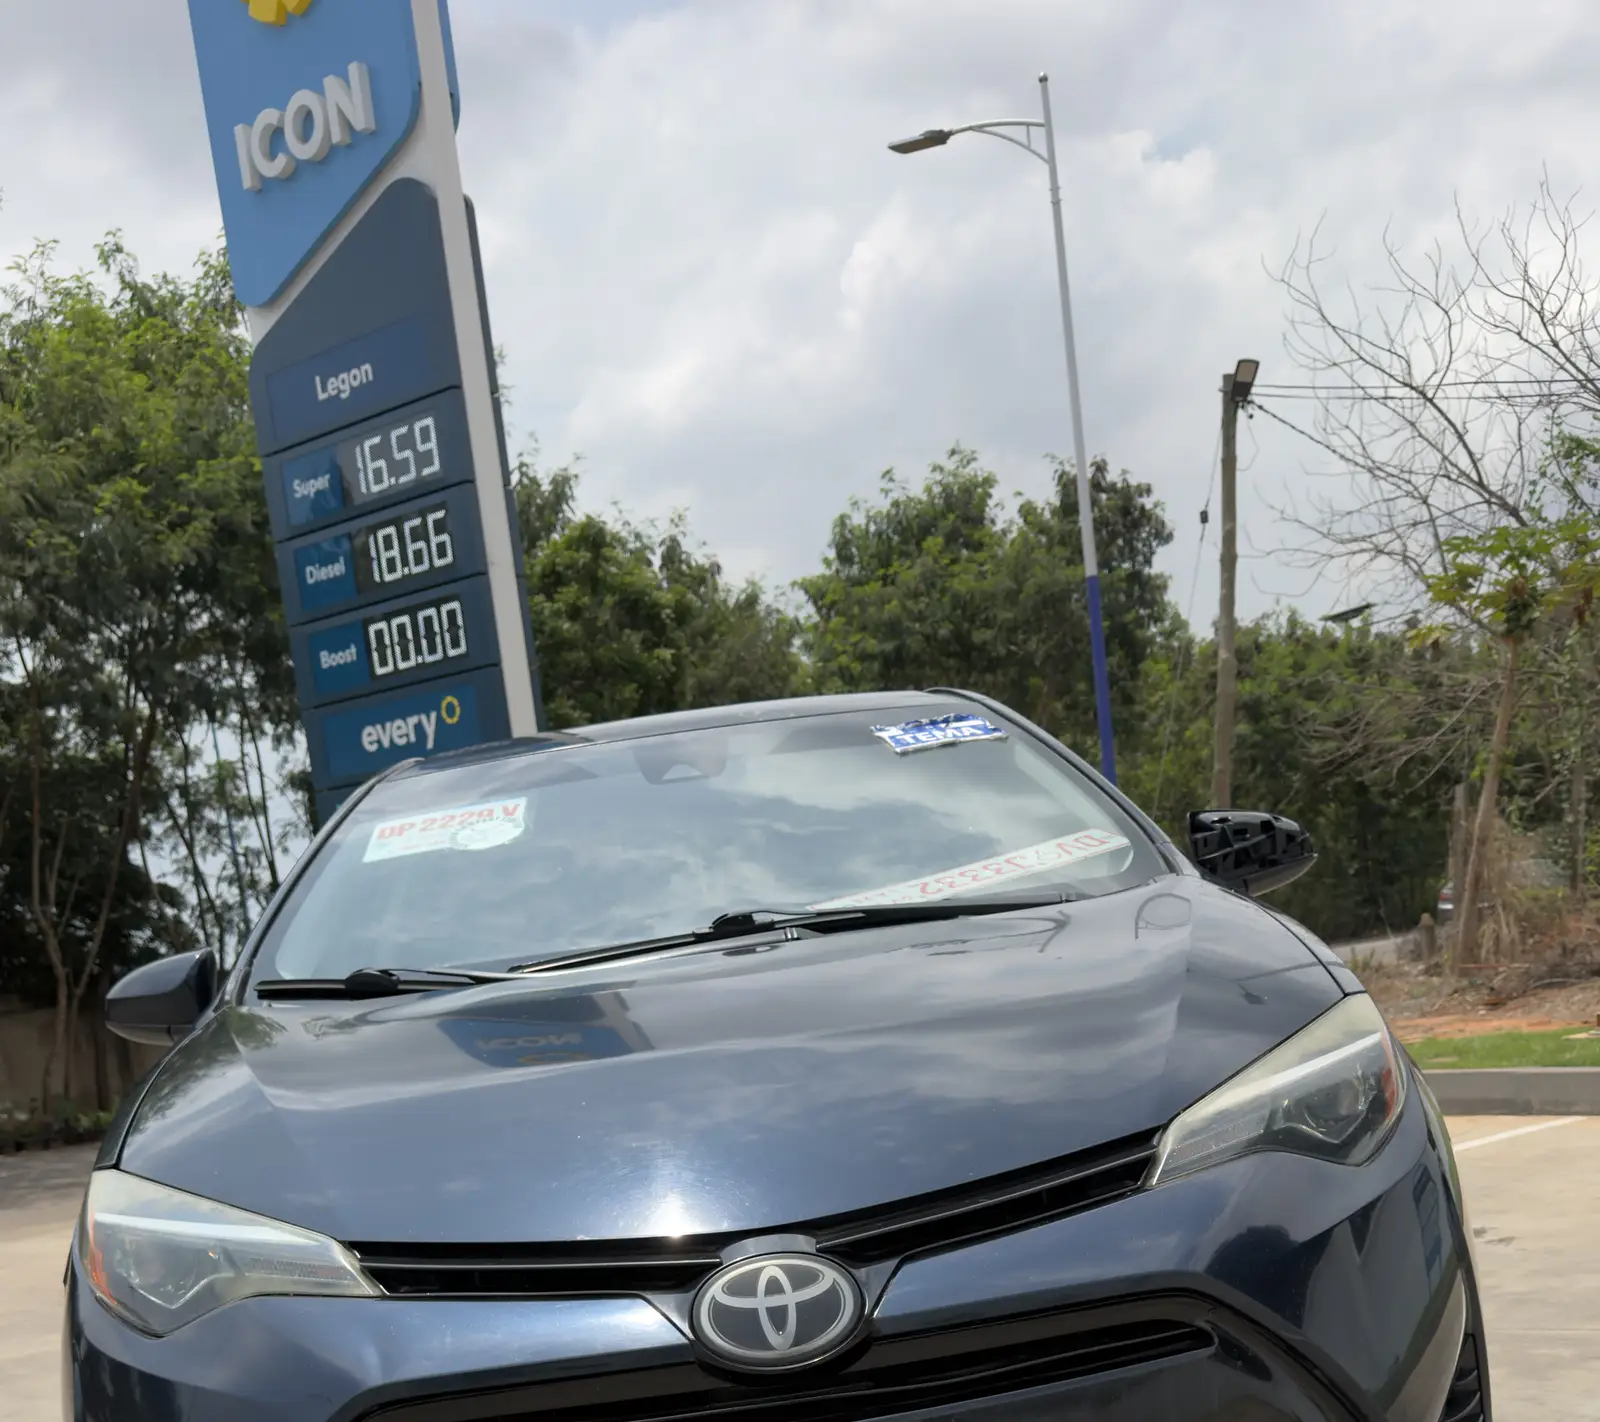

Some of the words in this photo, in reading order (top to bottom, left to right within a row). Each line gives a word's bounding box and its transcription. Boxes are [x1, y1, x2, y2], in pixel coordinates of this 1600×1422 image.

[234, 61, 376, 192] ICON
[314, 362, 375, 402] Legon
[291, 471, 332, 500] Super
[355, 415, 441, 495] 16.59
[304, 555, 346, 585] Diesel
[367, 508, 454, 583] 18.66
[319, 642, 358, 670] Boost
[367, 600, 468, 676] 00.00
[895, 725, 984, 745] TEMA
